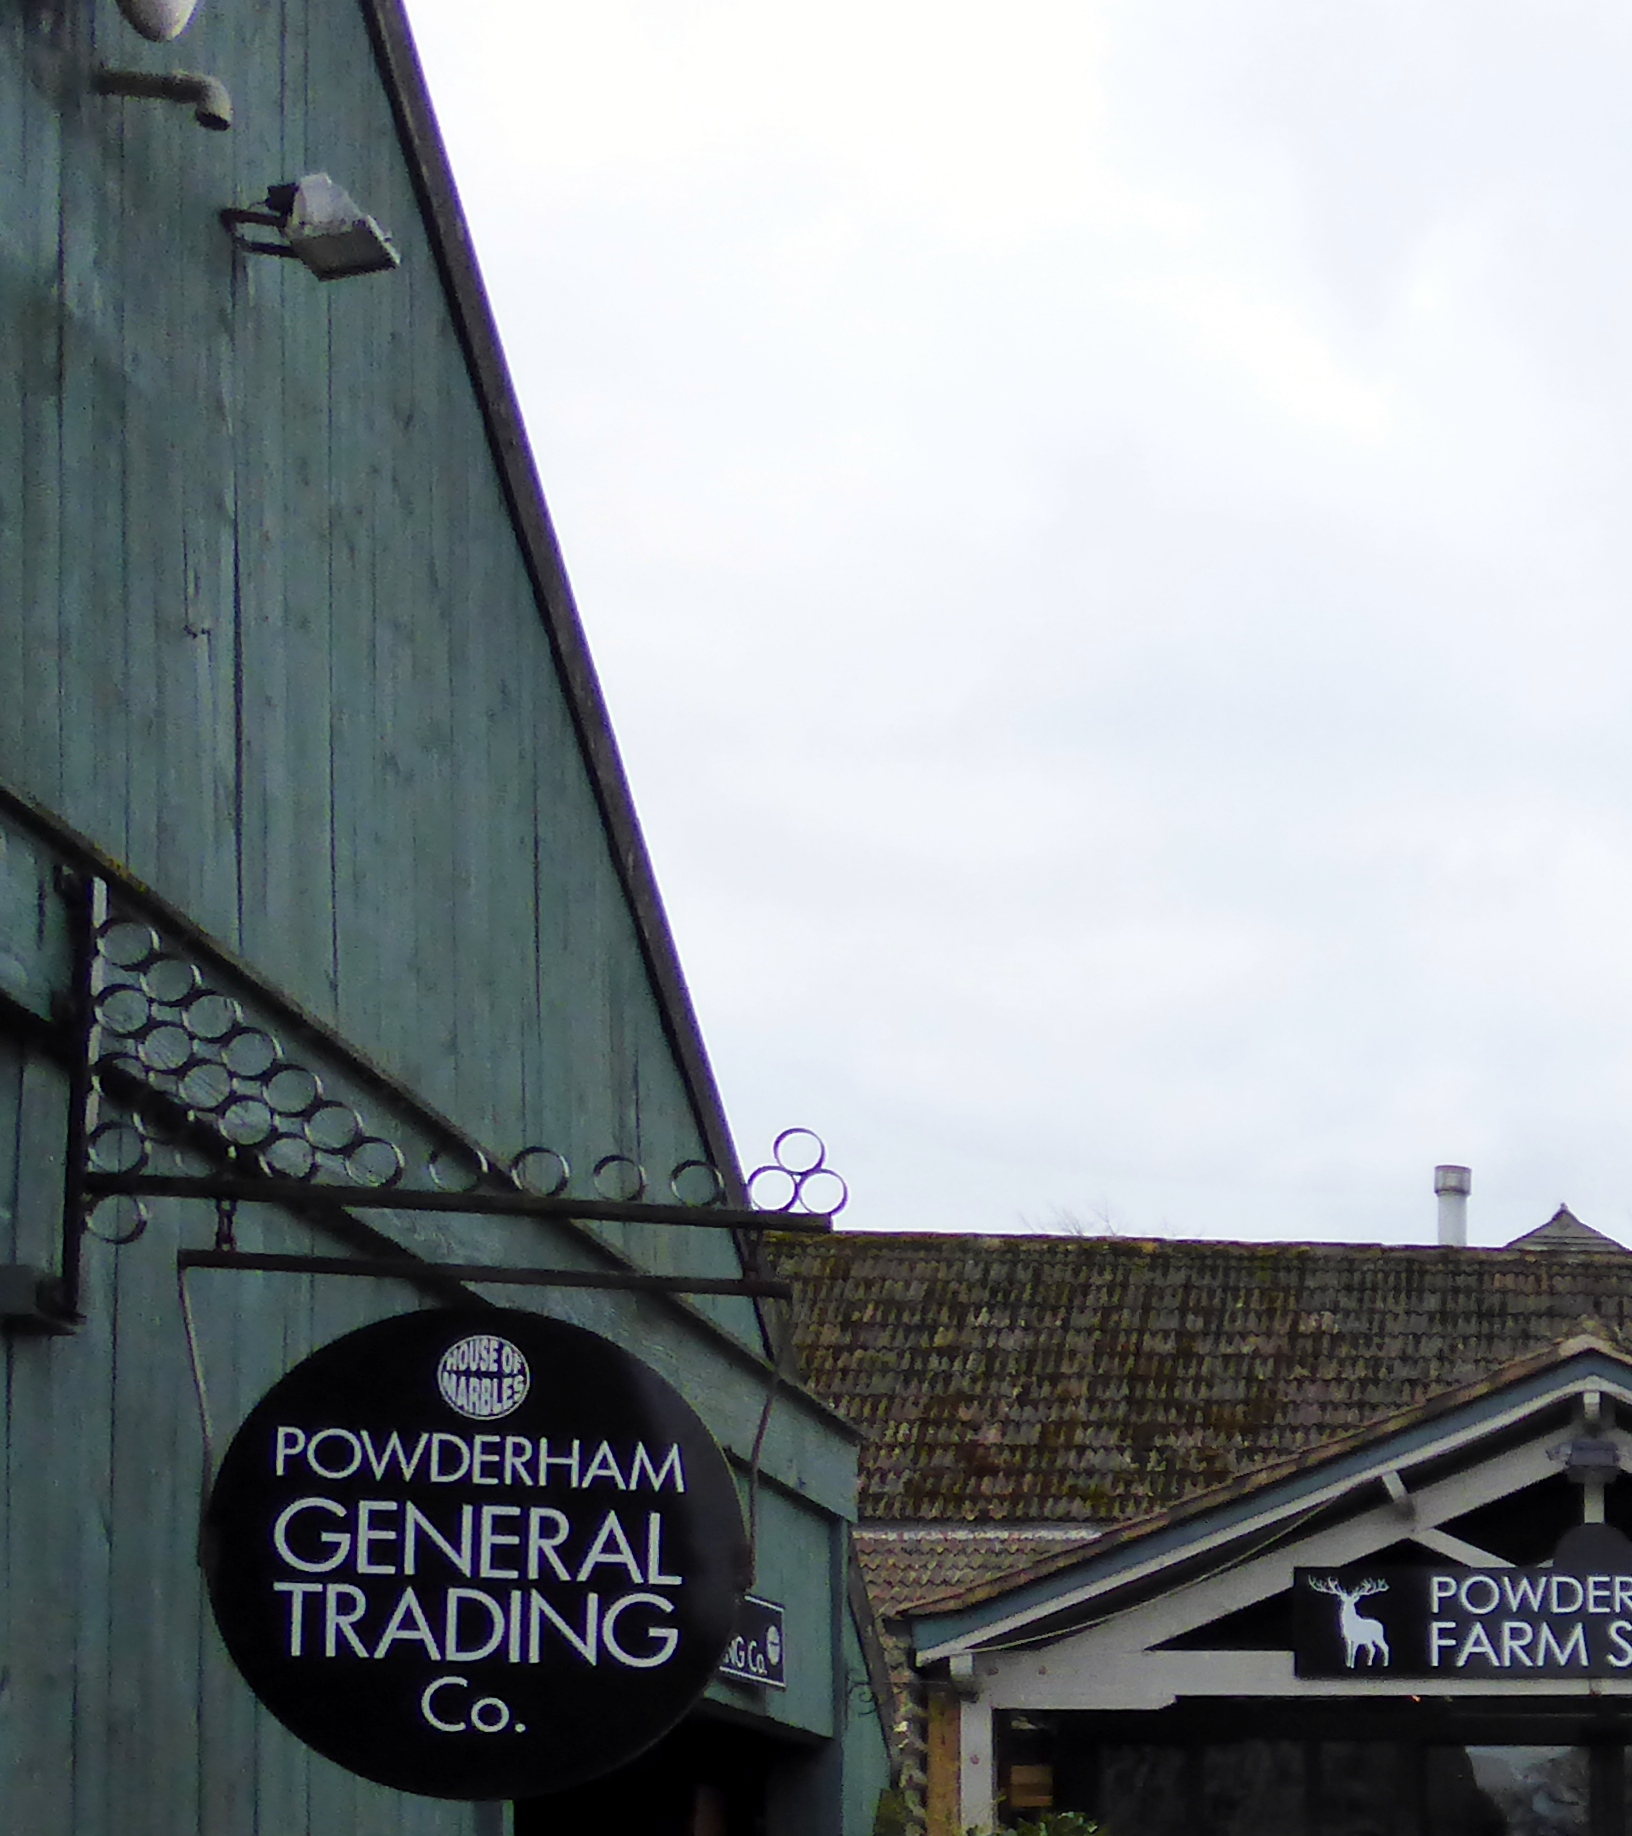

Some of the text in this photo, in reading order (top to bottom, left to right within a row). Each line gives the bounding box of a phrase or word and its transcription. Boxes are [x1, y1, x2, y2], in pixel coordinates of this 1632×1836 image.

[446, 1338, 522, 1375] HOUSE OF
[443, 1371, 525, 1416] MARBLES
[275, 1426, 686, 1493] POWDERHAM
[272, 1497, 683, 1586] GENERAL
[272, 1582, 679, 1668] TRADING
[1428, 1620, 1590, 1668] FARM
[420, 1676, 526, 1734] Co.
